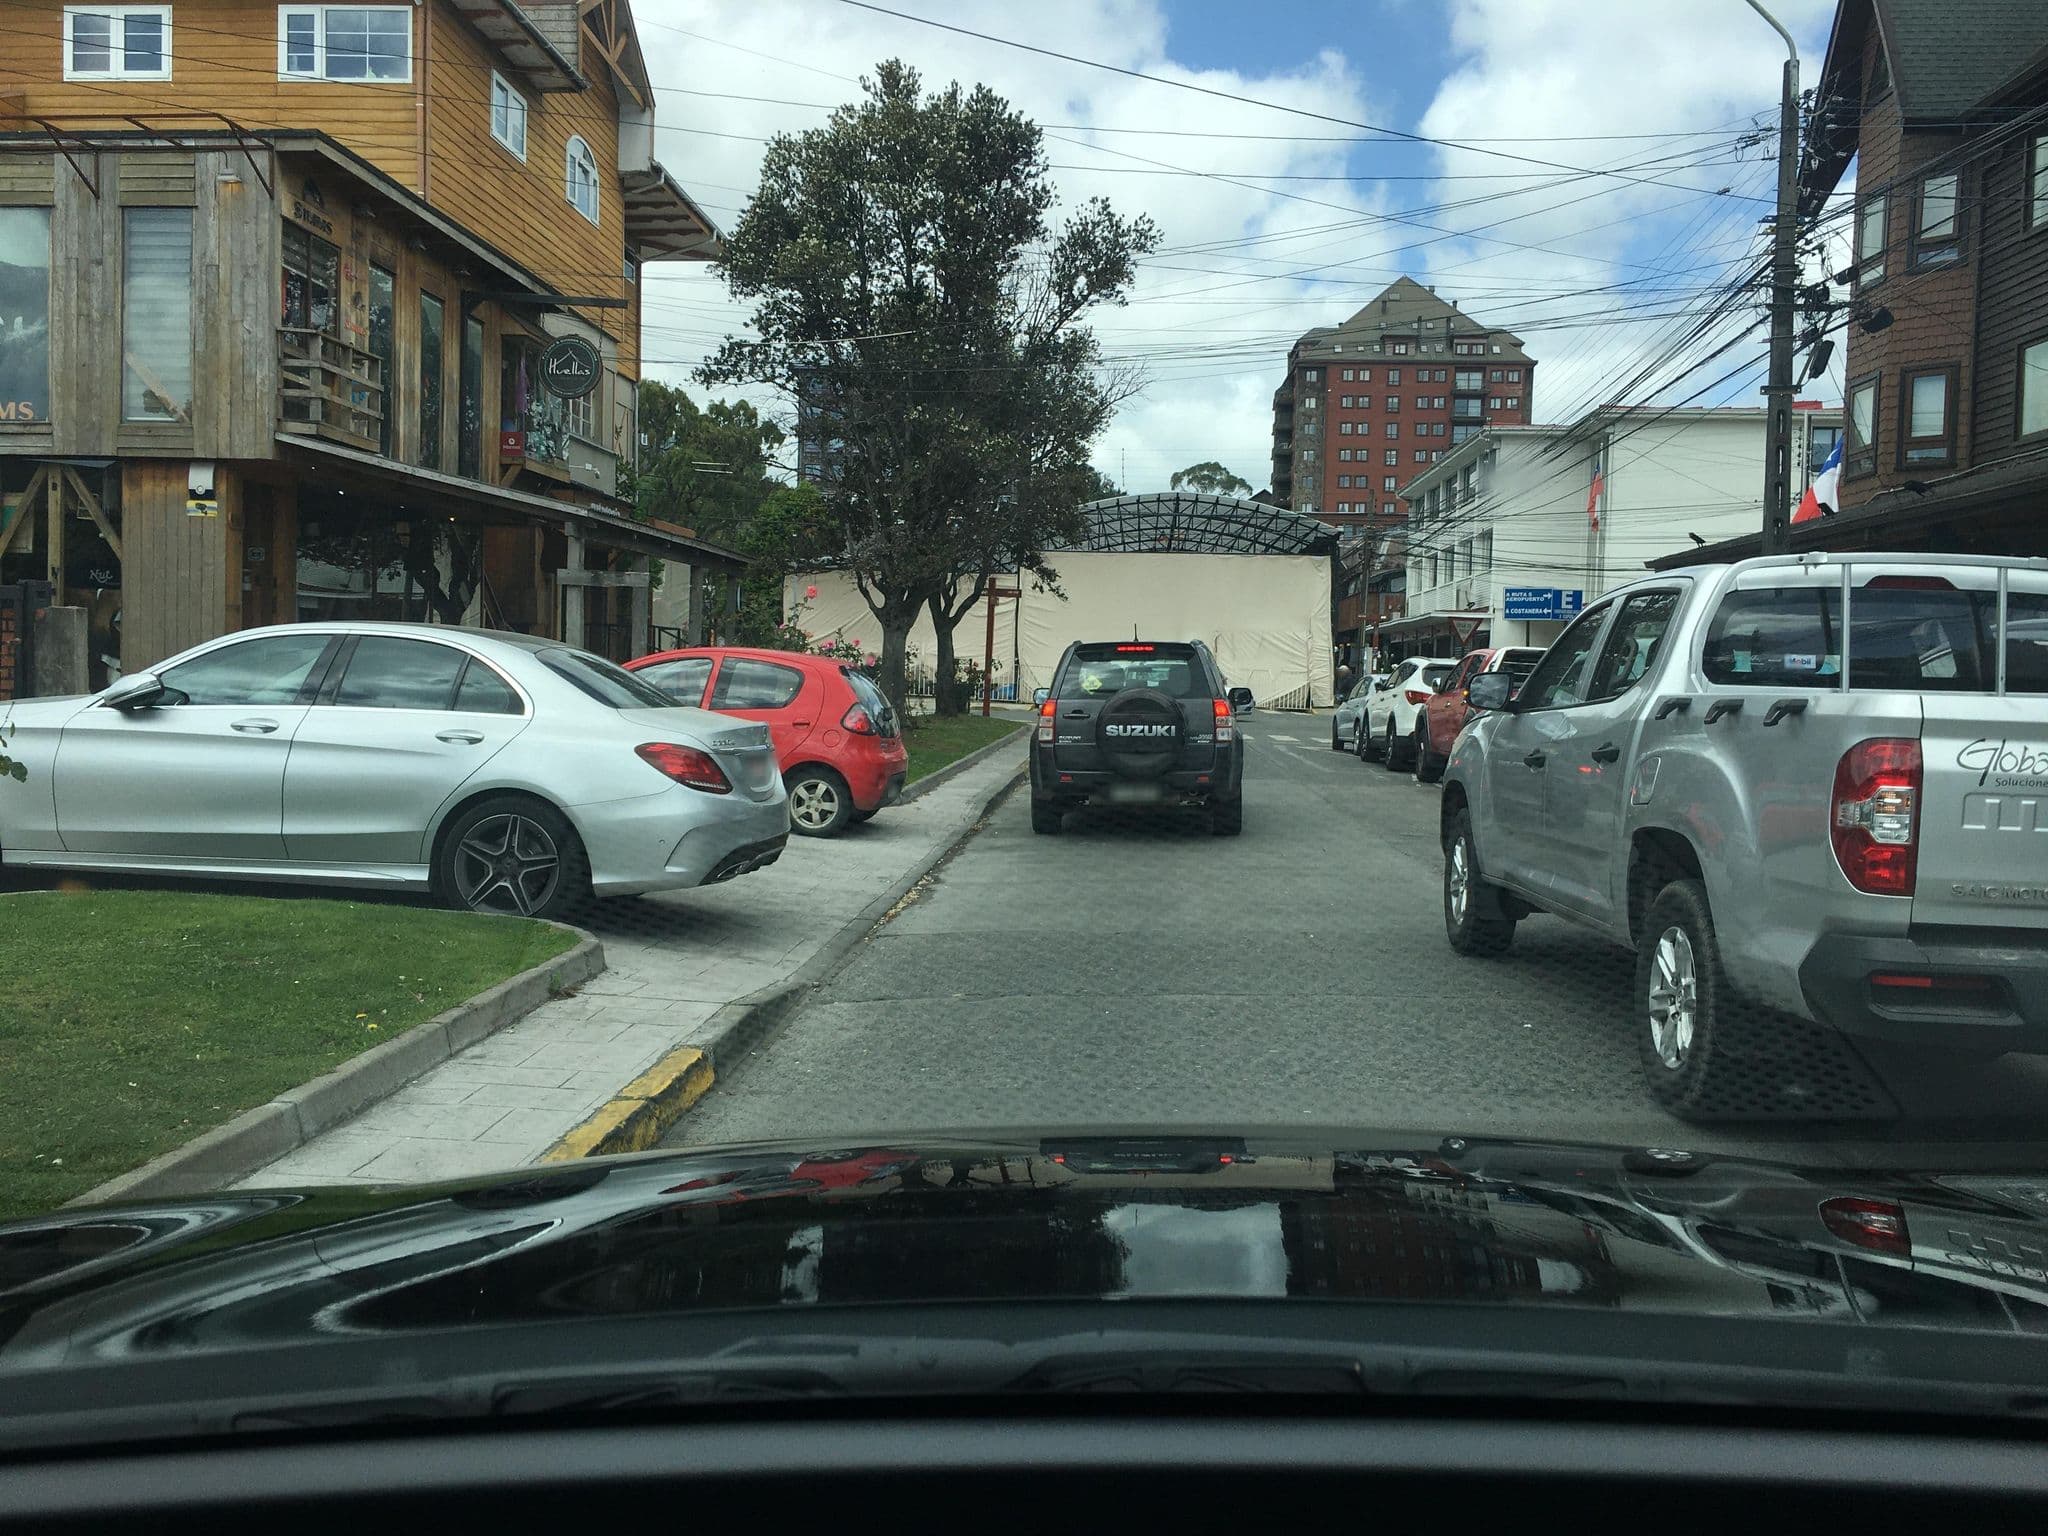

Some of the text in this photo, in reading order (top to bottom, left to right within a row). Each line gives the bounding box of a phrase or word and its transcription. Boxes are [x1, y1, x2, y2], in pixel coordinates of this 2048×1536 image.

[549, 358, 591, 375] Huellas
[1561, 590, 1573, 609] E
[1105, 725, 1176, 737] SUZUKI
